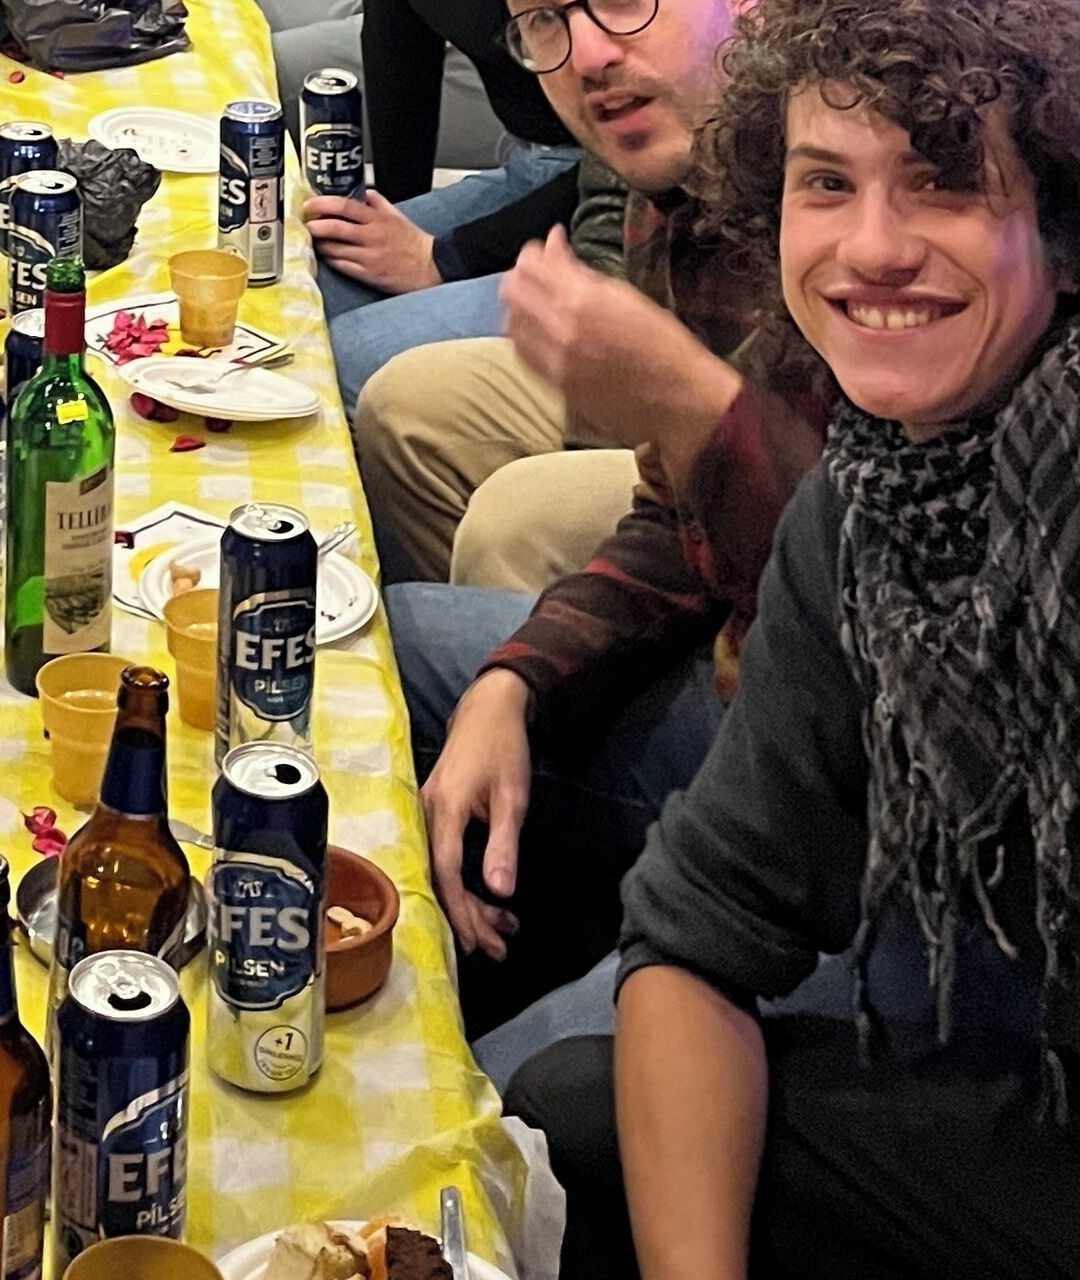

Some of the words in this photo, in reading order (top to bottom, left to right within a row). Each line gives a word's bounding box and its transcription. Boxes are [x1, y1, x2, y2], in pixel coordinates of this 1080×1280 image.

[307, 145, 362, 171] EFES
[220, 177, 247, 206] ES
[236, 624, 315, 671] EFES
[215, 949, 285, 978] PLSEN
